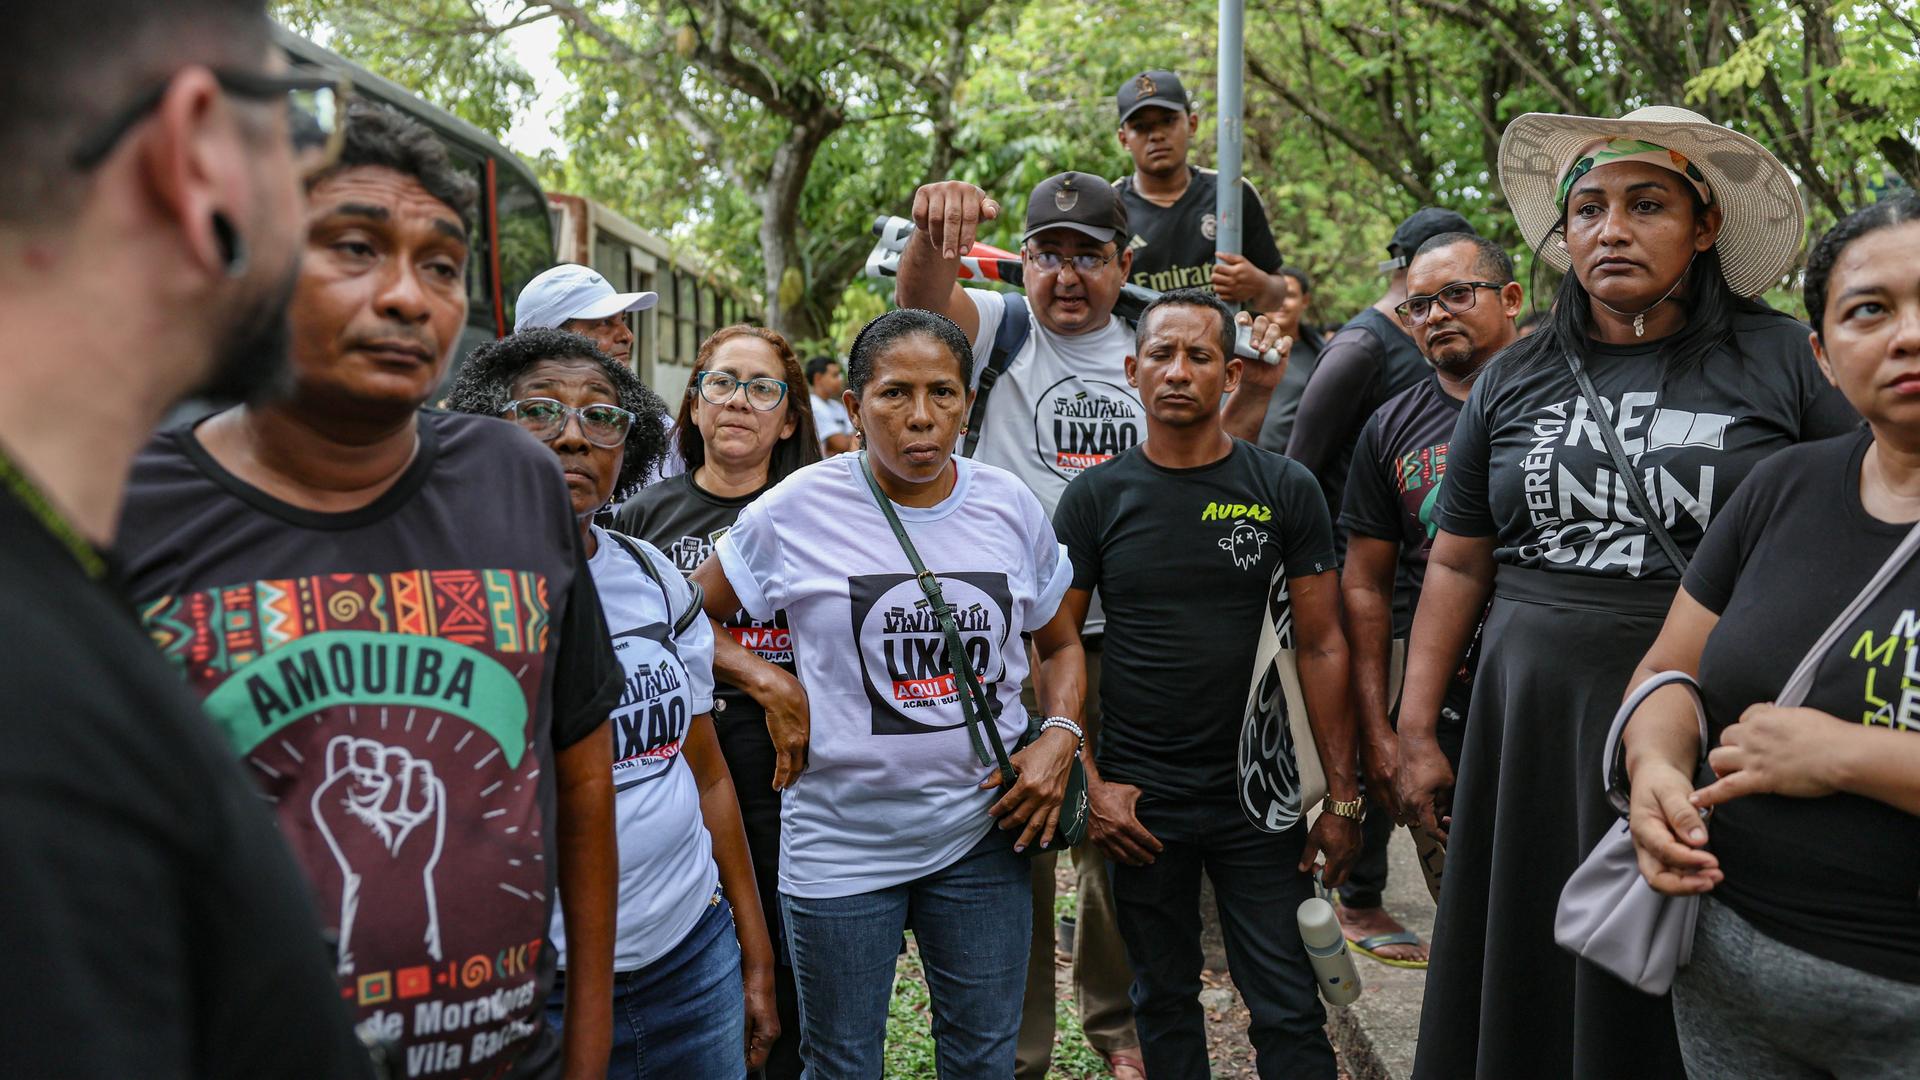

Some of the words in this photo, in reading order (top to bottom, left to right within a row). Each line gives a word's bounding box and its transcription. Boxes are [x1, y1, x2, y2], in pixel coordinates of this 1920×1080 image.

[1134, 262, 1216, 292] Emirat
[1053, 418, 1138, 456] LIXÃO
[1564, 391, 1658, 456] RE
[1201, 502, 1272, 521] AUDAZ
[741, 629, 791, 648] NÃO
[246, 642, 476, 727] AMQUIBA
[897, 681, 940, 699] AQUI
[903, 696, 936, 709] ACARÁ
[611, 695, 686, 762] IXÃO
[405, 1040, 464, 1078] Vila
